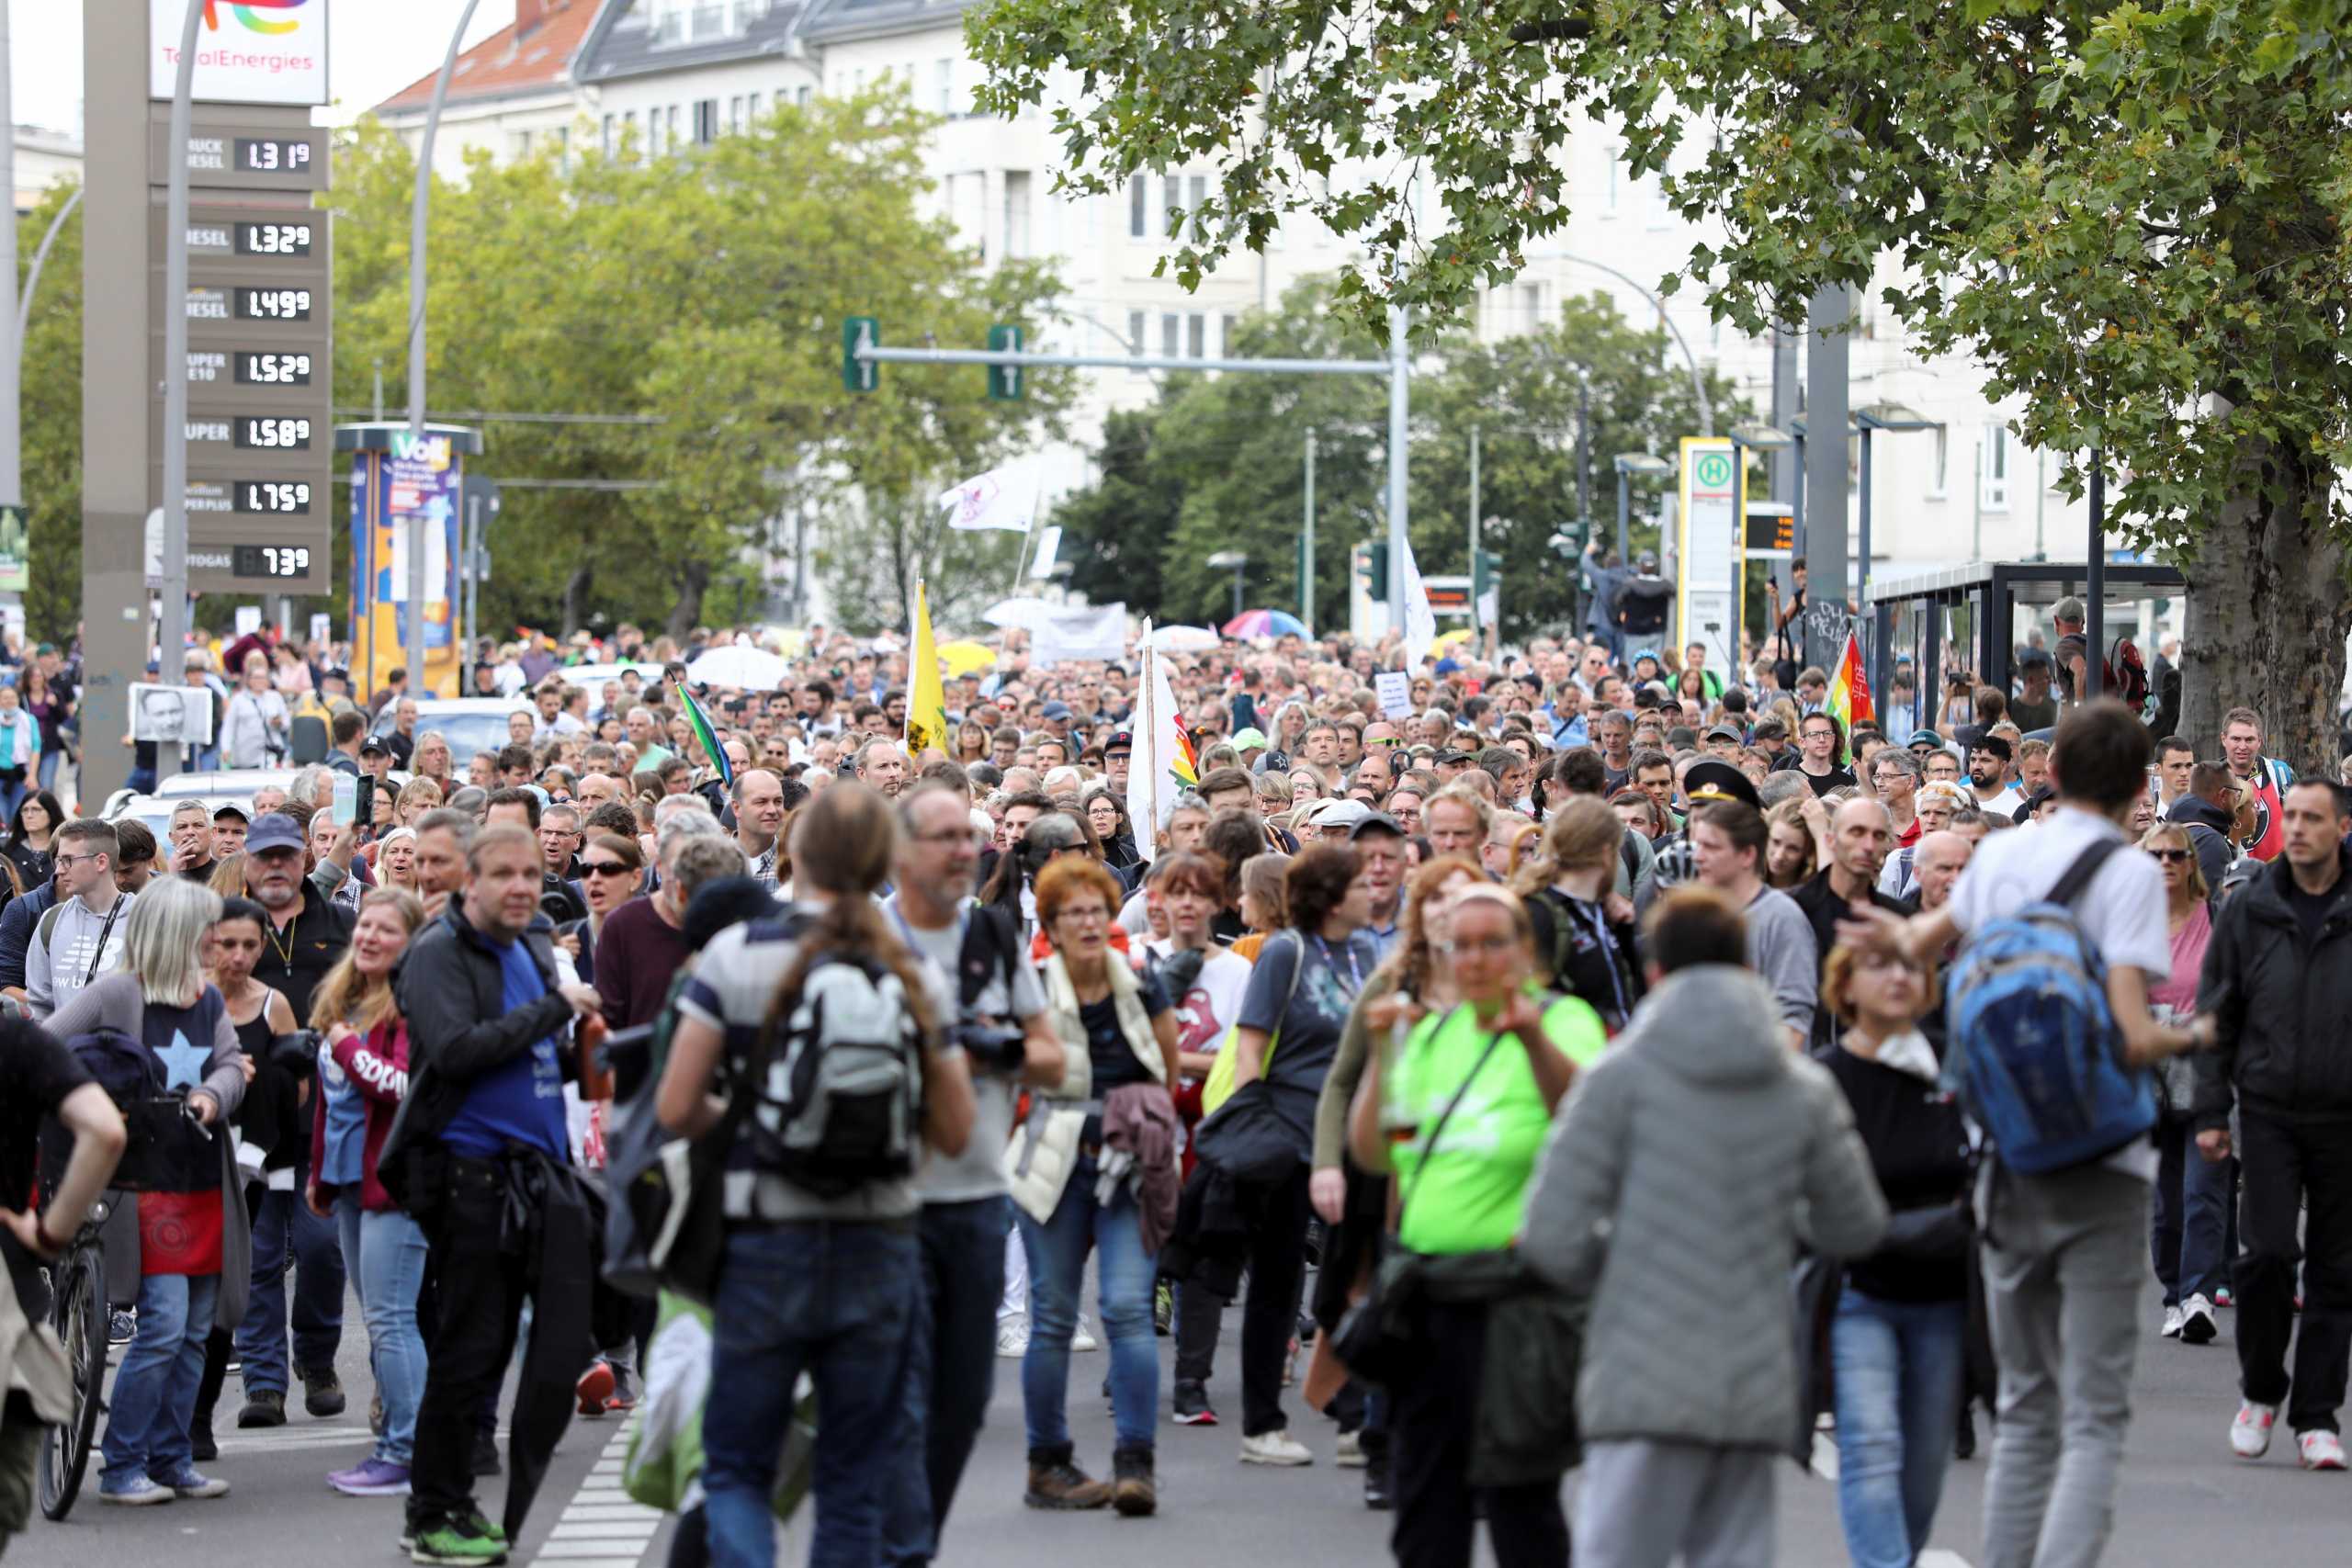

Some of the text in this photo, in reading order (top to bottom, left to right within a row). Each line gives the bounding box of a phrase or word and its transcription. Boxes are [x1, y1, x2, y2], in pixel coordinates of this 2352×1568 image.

[163, 47, 313, 73] ToalEnergies
[187, 139, 223, 153] RUCK
[186, 154, 224, 168] IESEL
[185, 229, 229, 246] IESEL
[185, 302, 229, 318] IESEL
[187, 354, 226, 367] UPER
[187, 368, 216, 381] E10
[184, 423, 230, 441] UPER
[184, 499, 206, 511] PER
[184, 554, 232, 568] TOGAS
